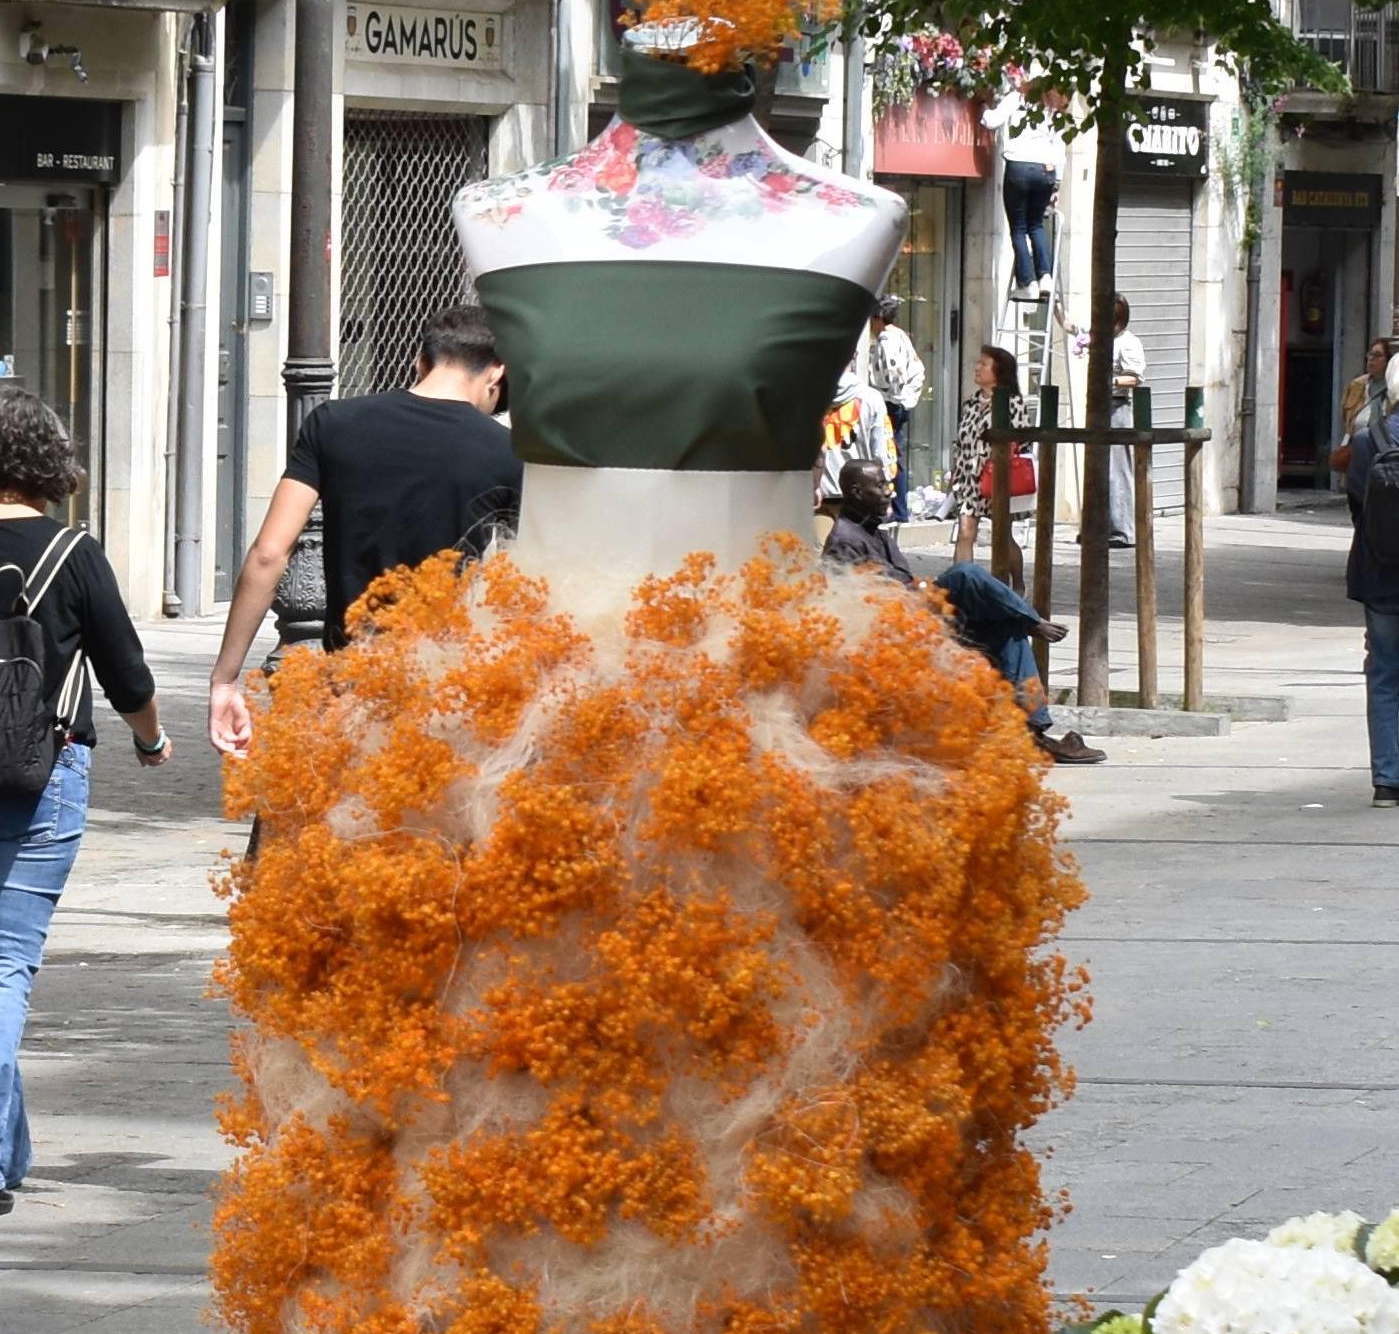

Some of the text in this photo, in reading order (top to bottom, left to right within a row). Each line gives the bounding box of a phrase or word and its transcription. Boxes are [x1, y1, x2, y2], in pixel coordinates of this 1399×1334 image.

[365, 10, 478, 61] GAMARÚS
[37, 153, 54, 168] BAR
[63, 154, 115, 170] RESTAURANT
